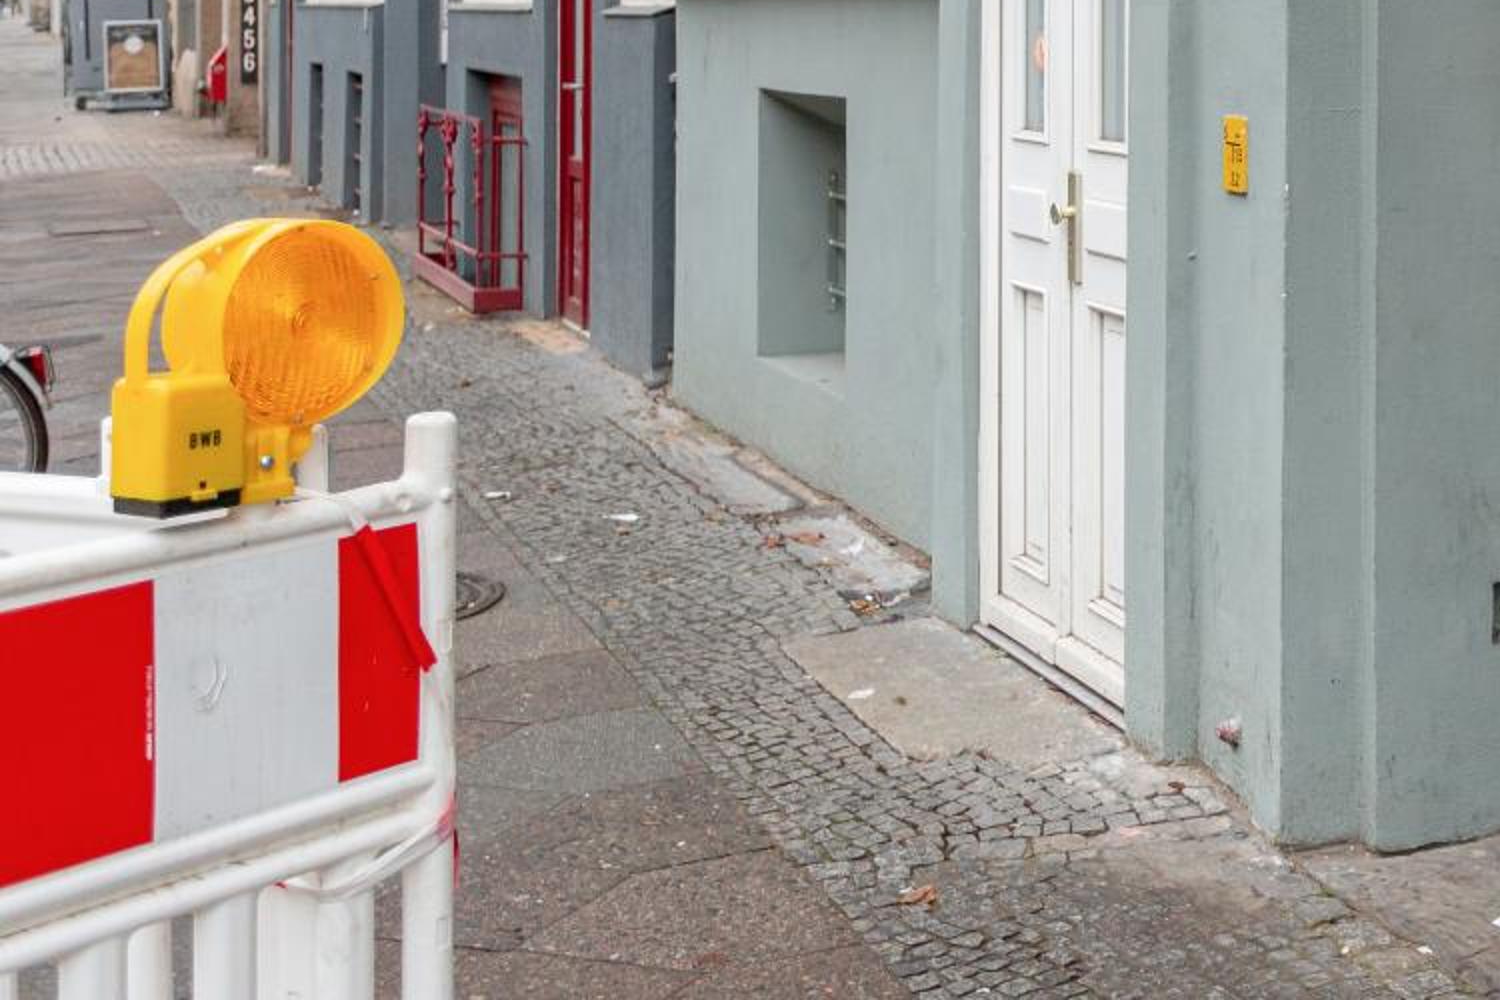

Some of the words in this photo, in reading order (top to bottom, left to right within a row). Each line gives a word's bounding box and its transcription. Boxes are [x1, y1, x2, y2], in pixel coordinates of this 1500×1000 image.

[243, 6, 255, 26] 4
[243, 28, 255, 49] 5
[243, 52, 255, 73] 6
[188, 429, 222, 450] BWB
